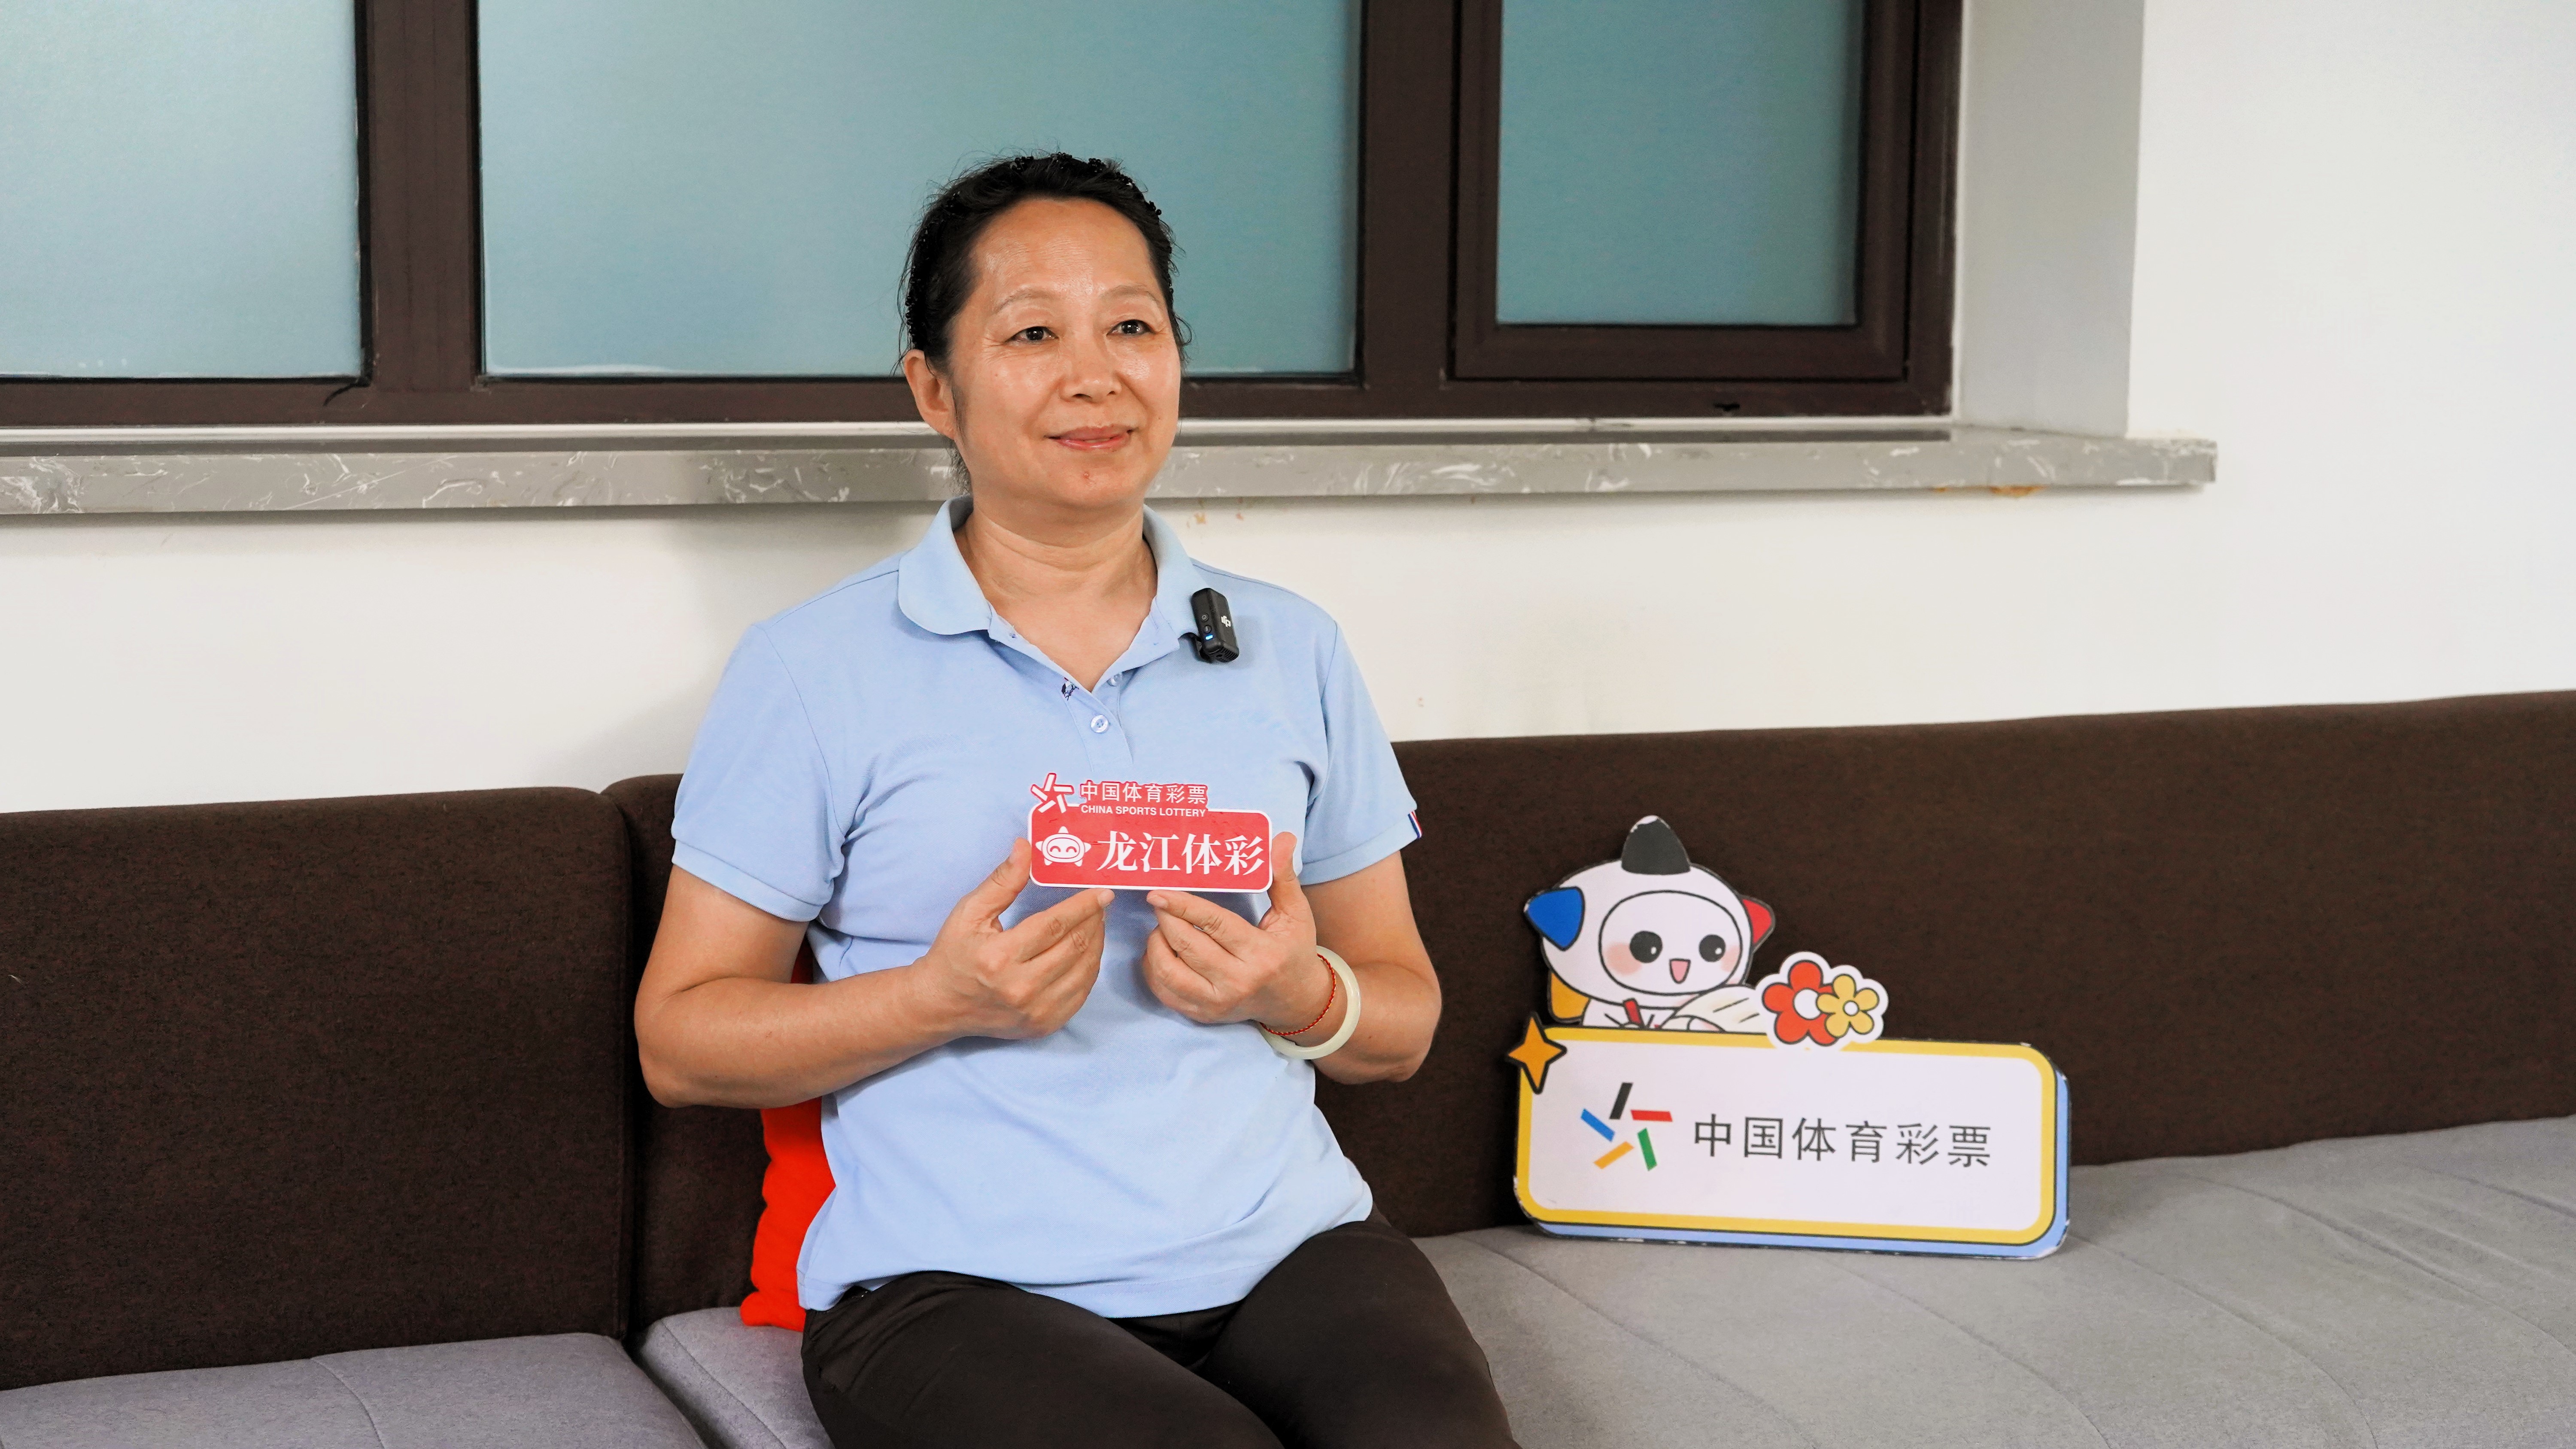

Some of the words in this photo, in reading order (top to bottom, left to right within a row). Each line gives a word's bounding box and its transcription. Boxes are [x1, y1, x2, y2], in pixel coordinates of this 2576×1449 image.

[1081, 781, 1207, 804] 中国体育彩票
[1081, 805, 1113, 814] CHINA
[1115, 806, 1157, 815] SPORTS
[1159, 808, 1206, 817] LOTTERY
[1096, 831, 1265, 876] 龙江体彩
[1694, 1114, 1991, 1168] 中国体育彩票
